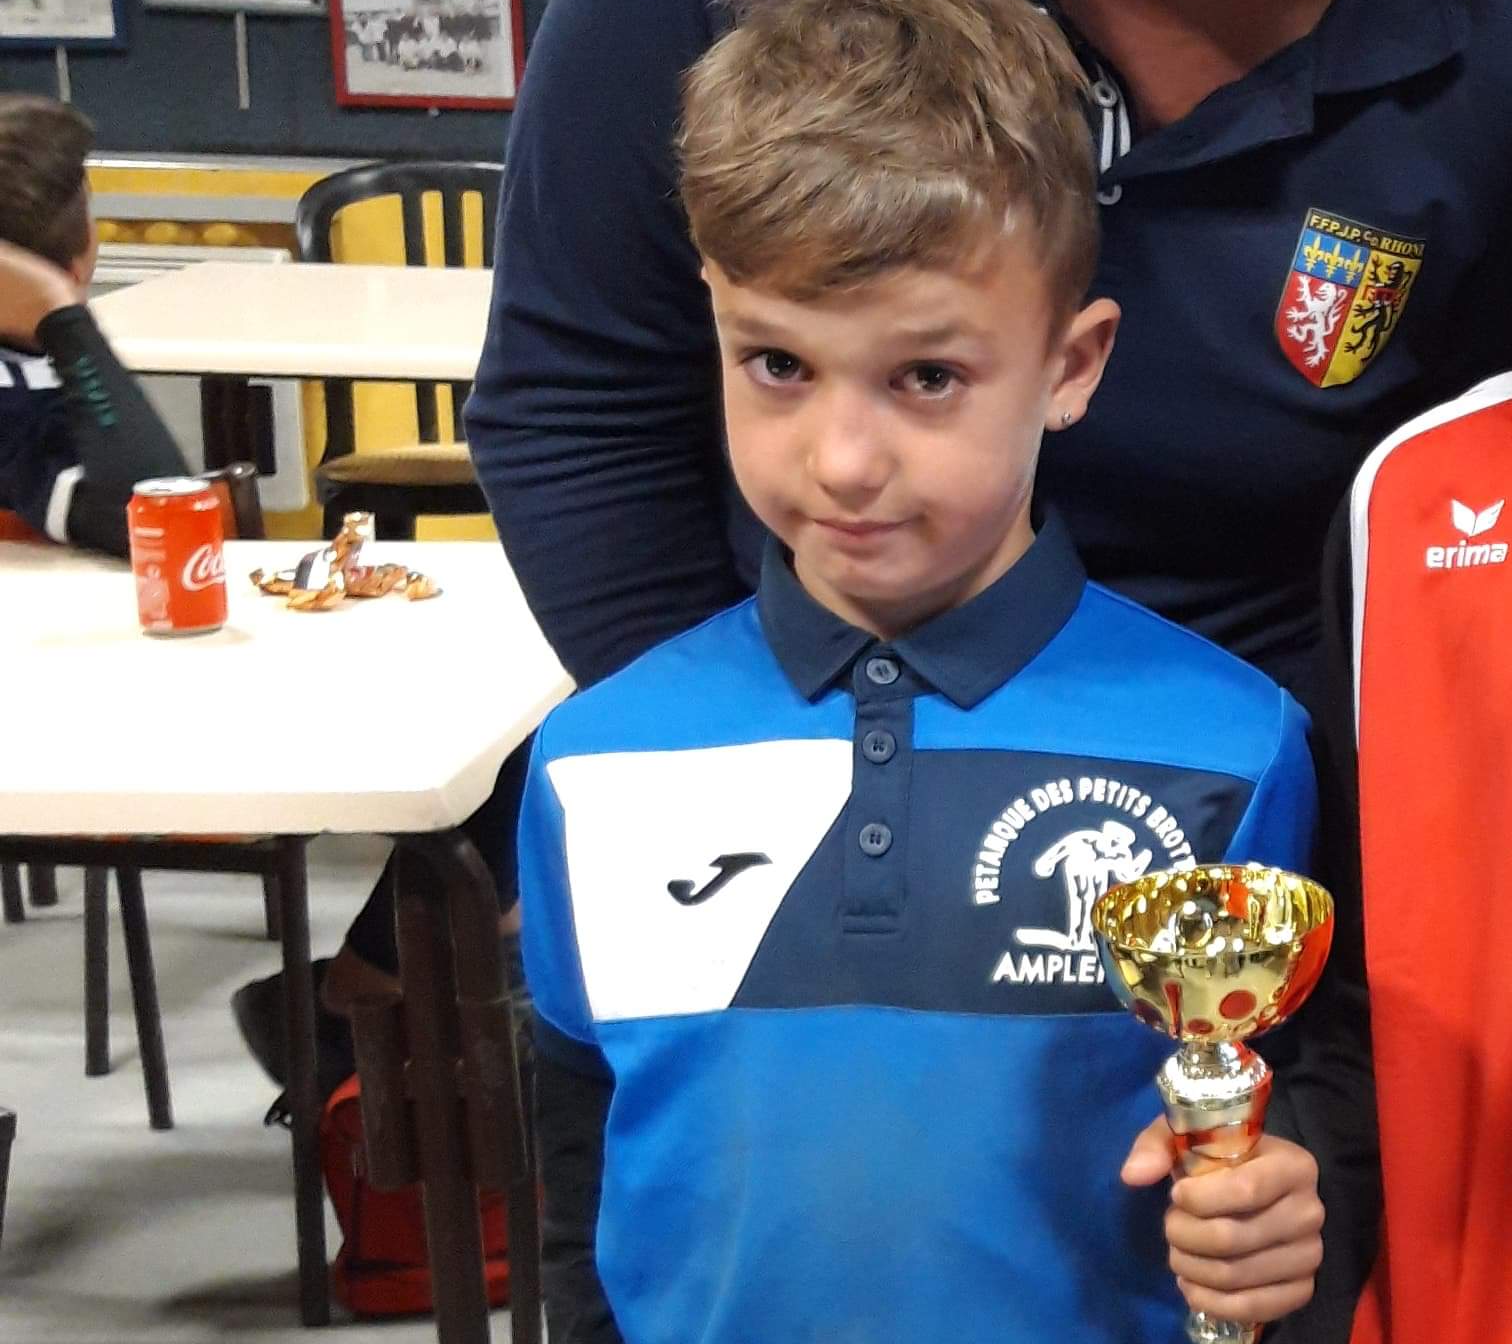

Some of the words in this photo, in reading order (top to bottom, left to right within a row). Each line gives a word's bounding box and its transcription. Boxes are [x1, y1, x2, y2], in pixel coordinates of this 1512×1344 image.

[1425, 539, 1509, 569] erima
[974, 798, 1036, 905] PETANQUE
[1030, 778, 1074, 813] DES
[1078, 777, 1152, 817] PETITS
[993, 952, 1106, 984] AMPLE
